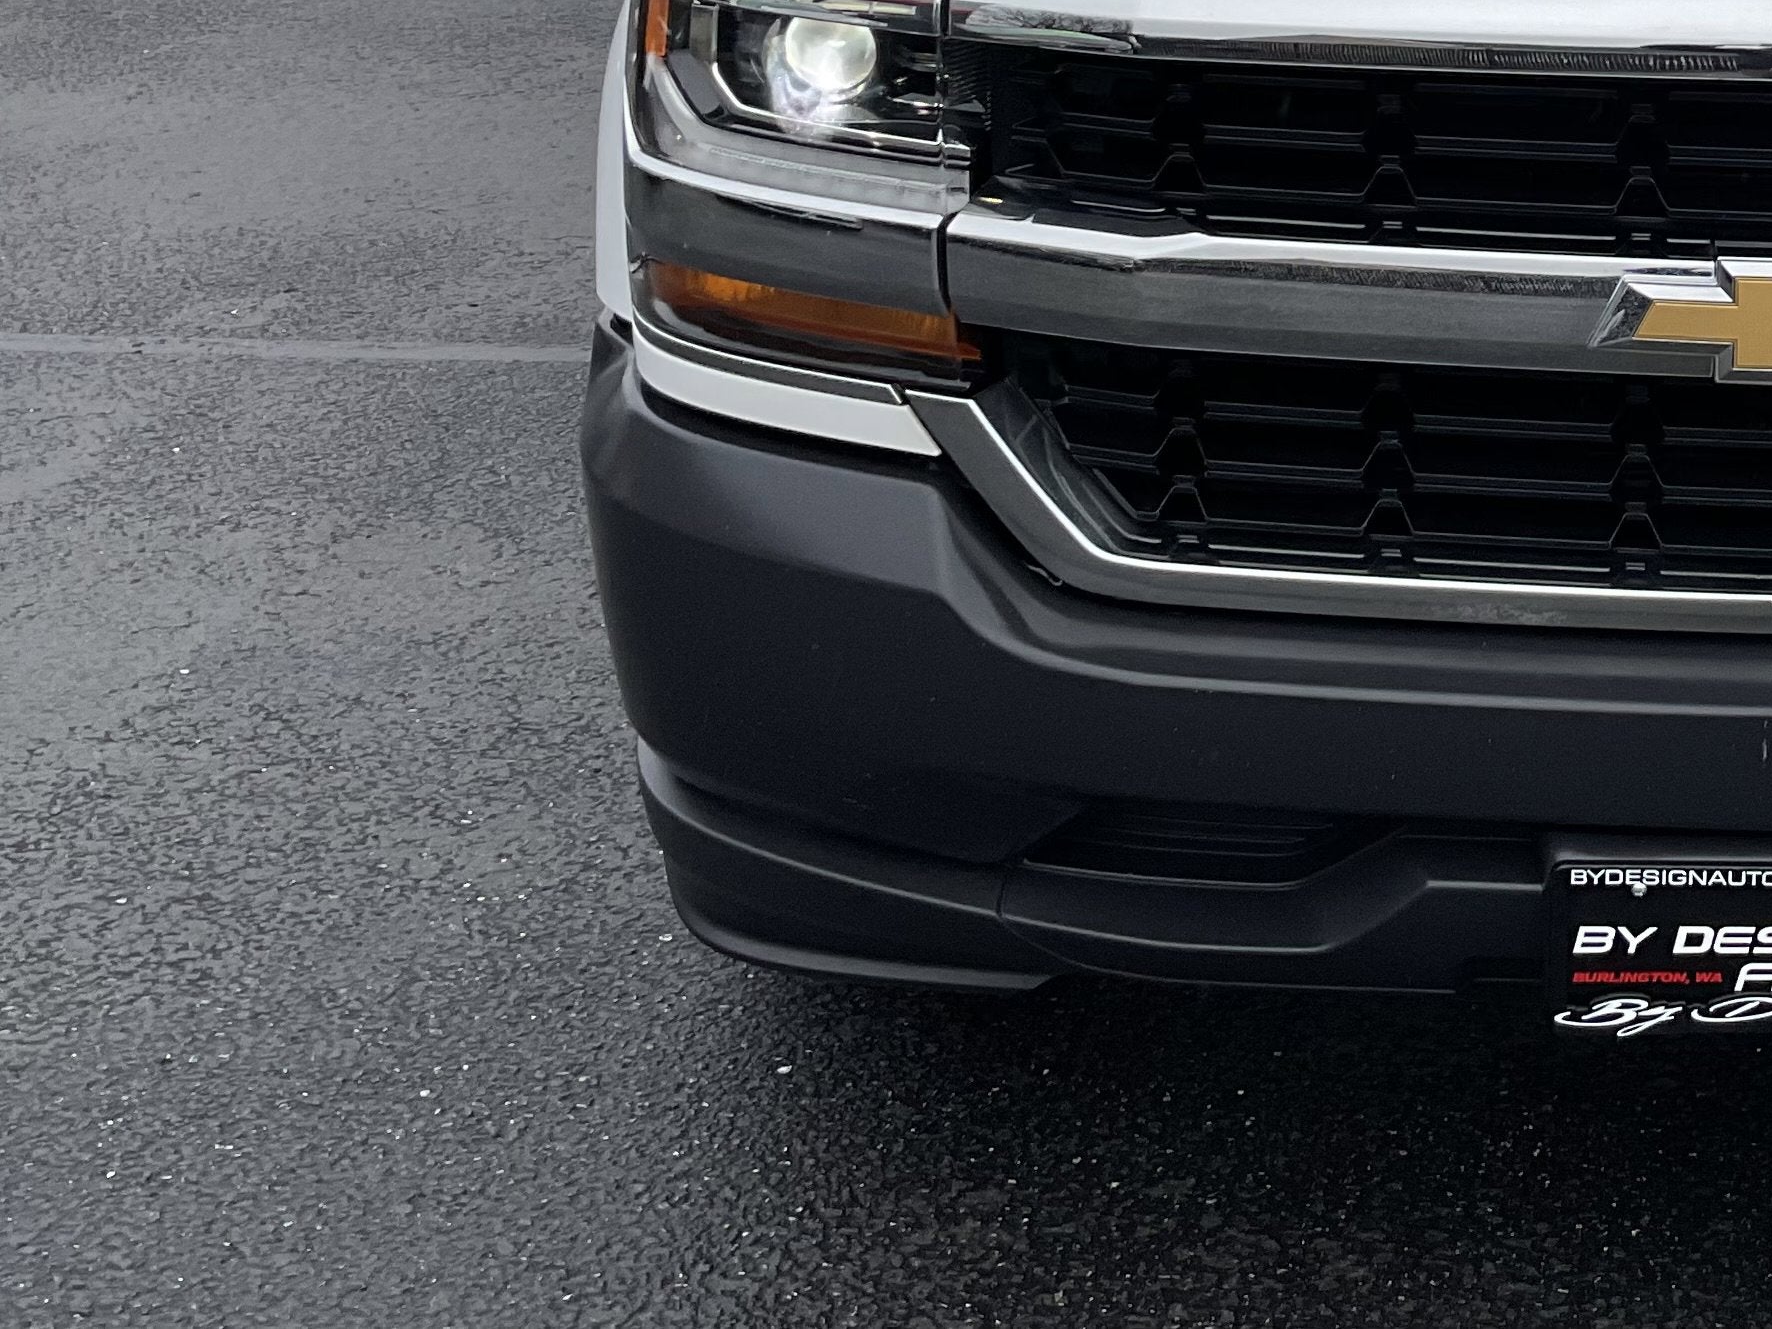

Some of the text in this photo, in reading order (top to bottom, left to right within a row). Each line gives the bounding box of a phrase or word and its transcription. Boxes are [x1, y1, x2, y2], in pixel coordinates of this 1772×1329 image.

[1572, 925, 1658, 954] BY
[1572, 971, 1723, 985] BURLINGTON, WA
[1553, 998, 1683, 1037] By
